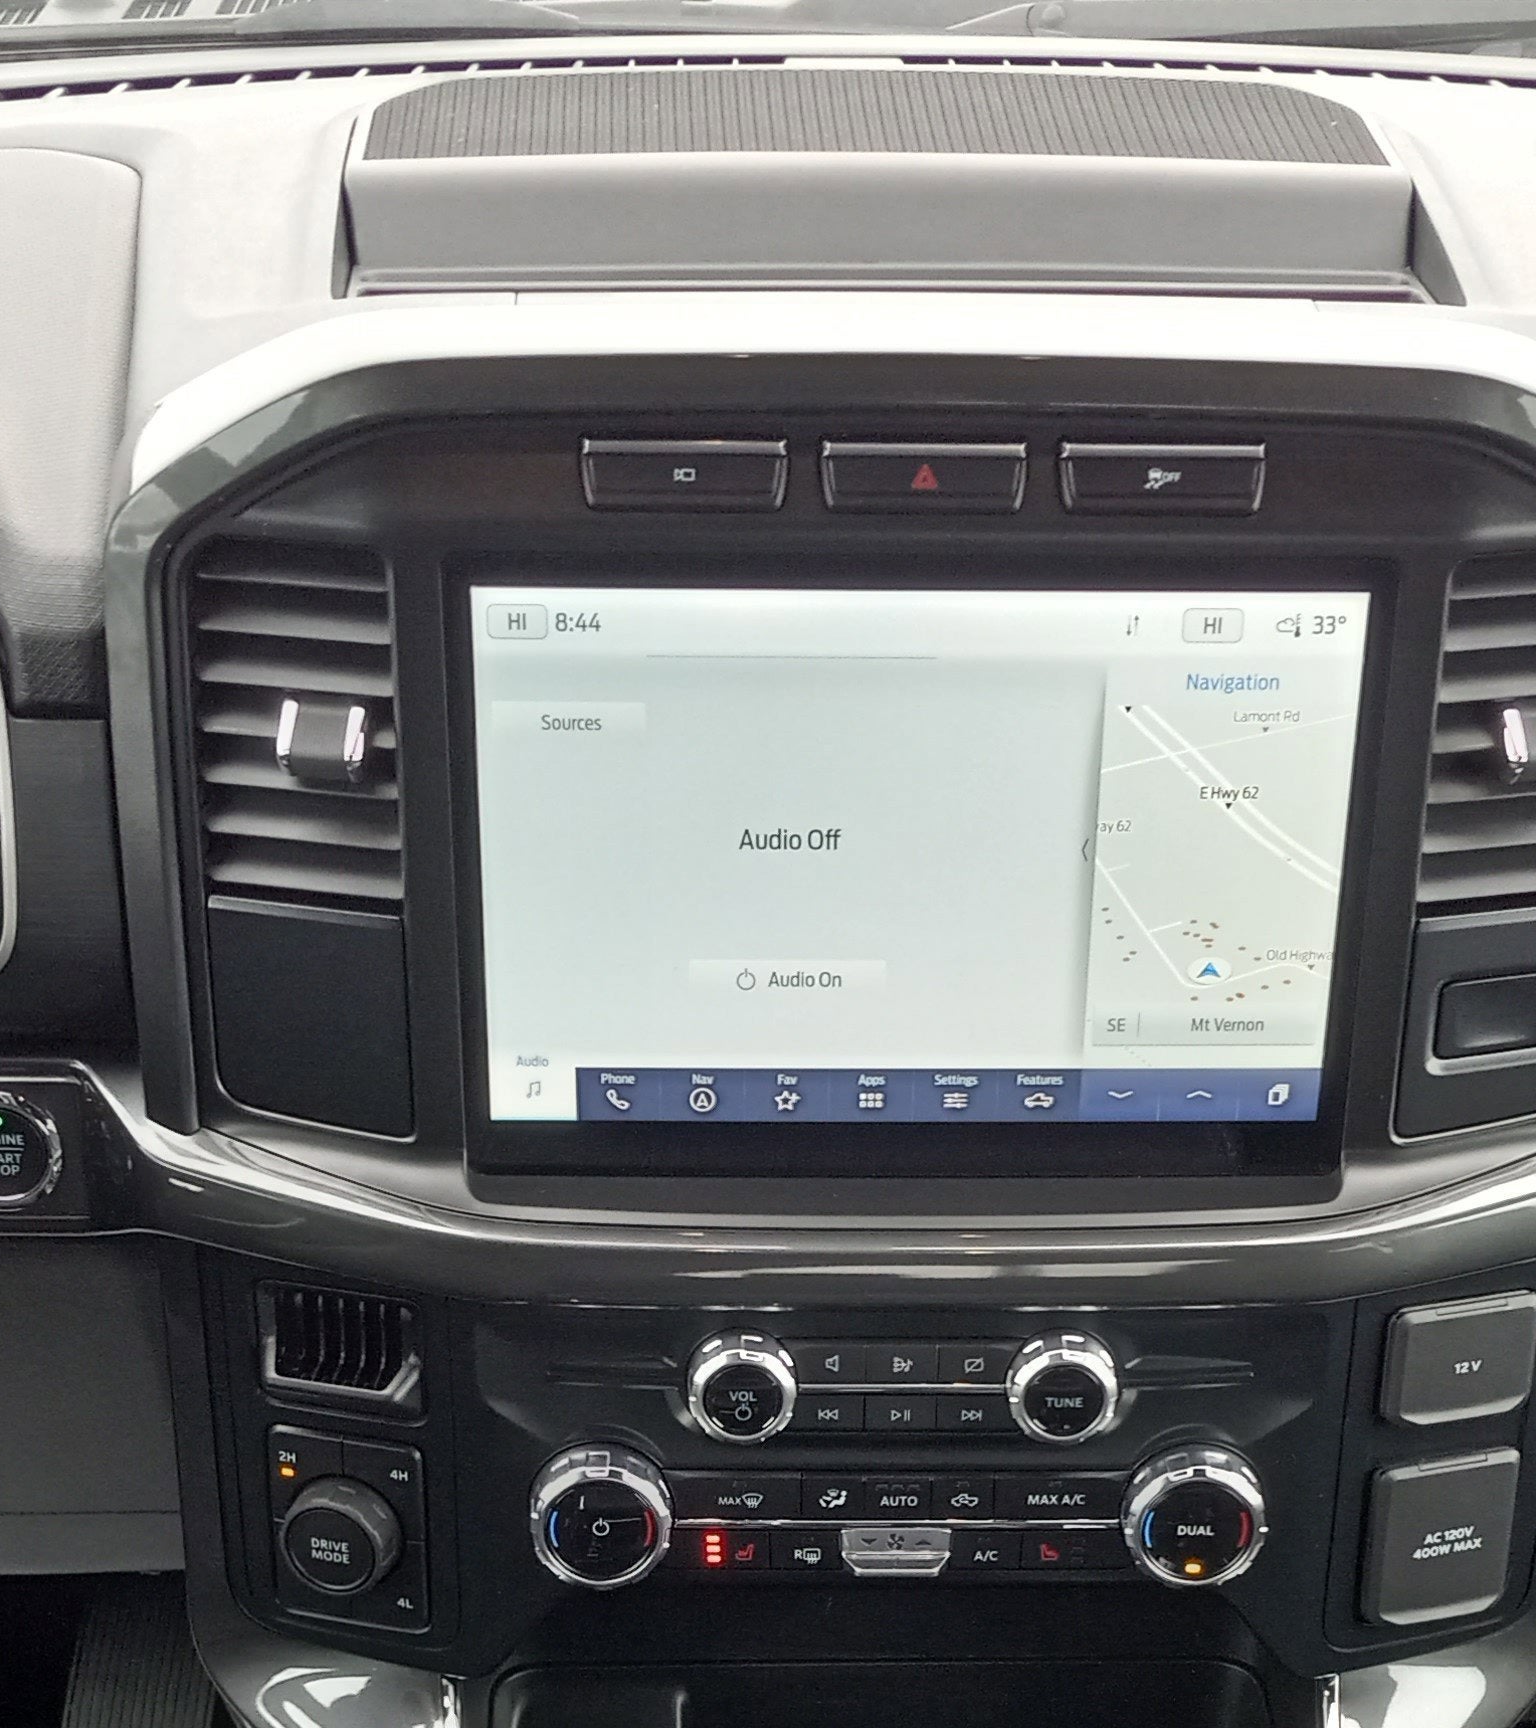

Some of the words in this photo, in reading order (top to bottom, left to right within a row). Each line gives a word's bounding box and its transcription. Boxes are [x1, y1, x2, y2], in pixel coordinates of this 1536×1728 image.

[507, 612, 529, 632] HI
[554, 613, 602, 633] 8:44
[1203, 616, 1223, 634] HI
[1185, 673, 1280, 694] Navigation
[540, 713, 602, 732] Sources
[1233, 710, 1281, 723] Lamont
[1283, 710, 1301, 723] Rd
[1200, 786, 1208, 799] E
[1210, 786, 1241, 802] Hwy
[1241, 786, 1259, 799] 62
[1096, 822, 1114, 834] ay
[1117, 819, 1131, 832] 62
[739, 829, 803, 852] Audio
[807, 828, 842, 852] Off
[1266, 949, 1286, 961] Old
[768, 971, 814, 990] Audio
[818, 971, 843, 990] On
[1107, 1018, 1126, 1031] SE
[1190, 1018, 1211, 1031] Mt
[1214, 1018, 1264, 1031] Vernon
[516, 1055, 549, 1068] Audio
[600, 1073, 636, 1086] Phone
[692, 1073, 714, 1086] Nav
[777, 1074, 798, 1087] Fav
[857, 1074, 886, 1087] Apps
[934, 1074, 979, 1088] Settings
[1016, 1074, 1064, 1086] Features
[729, 1391, 757, 1401] VOL
[1045, 1397, 1084, 1408] TUNE
[278, 1450, 296, 1463] 2H
[390, 1470, 408, 1482] 4H
[718, 1496, 741, 1506] MAX
[880, 1496, 918, 1507] AUTO
[1027, 1494, 1058, 1506] MAX
[1061, 1493, 1086, 1506] A/C
[1177, 1525, 1214, 1536] DUAL
[1423, 1531, 1443, 1545] AC
[310, 1537, 349, 1553] DRIVE
[1452, 1537, 1482, 1553] MAX
[311, 1549, 350, 1564] MODE
[973, 1550, 999, 1562] A/C
[396, 1597, 413, 1609] 4L
